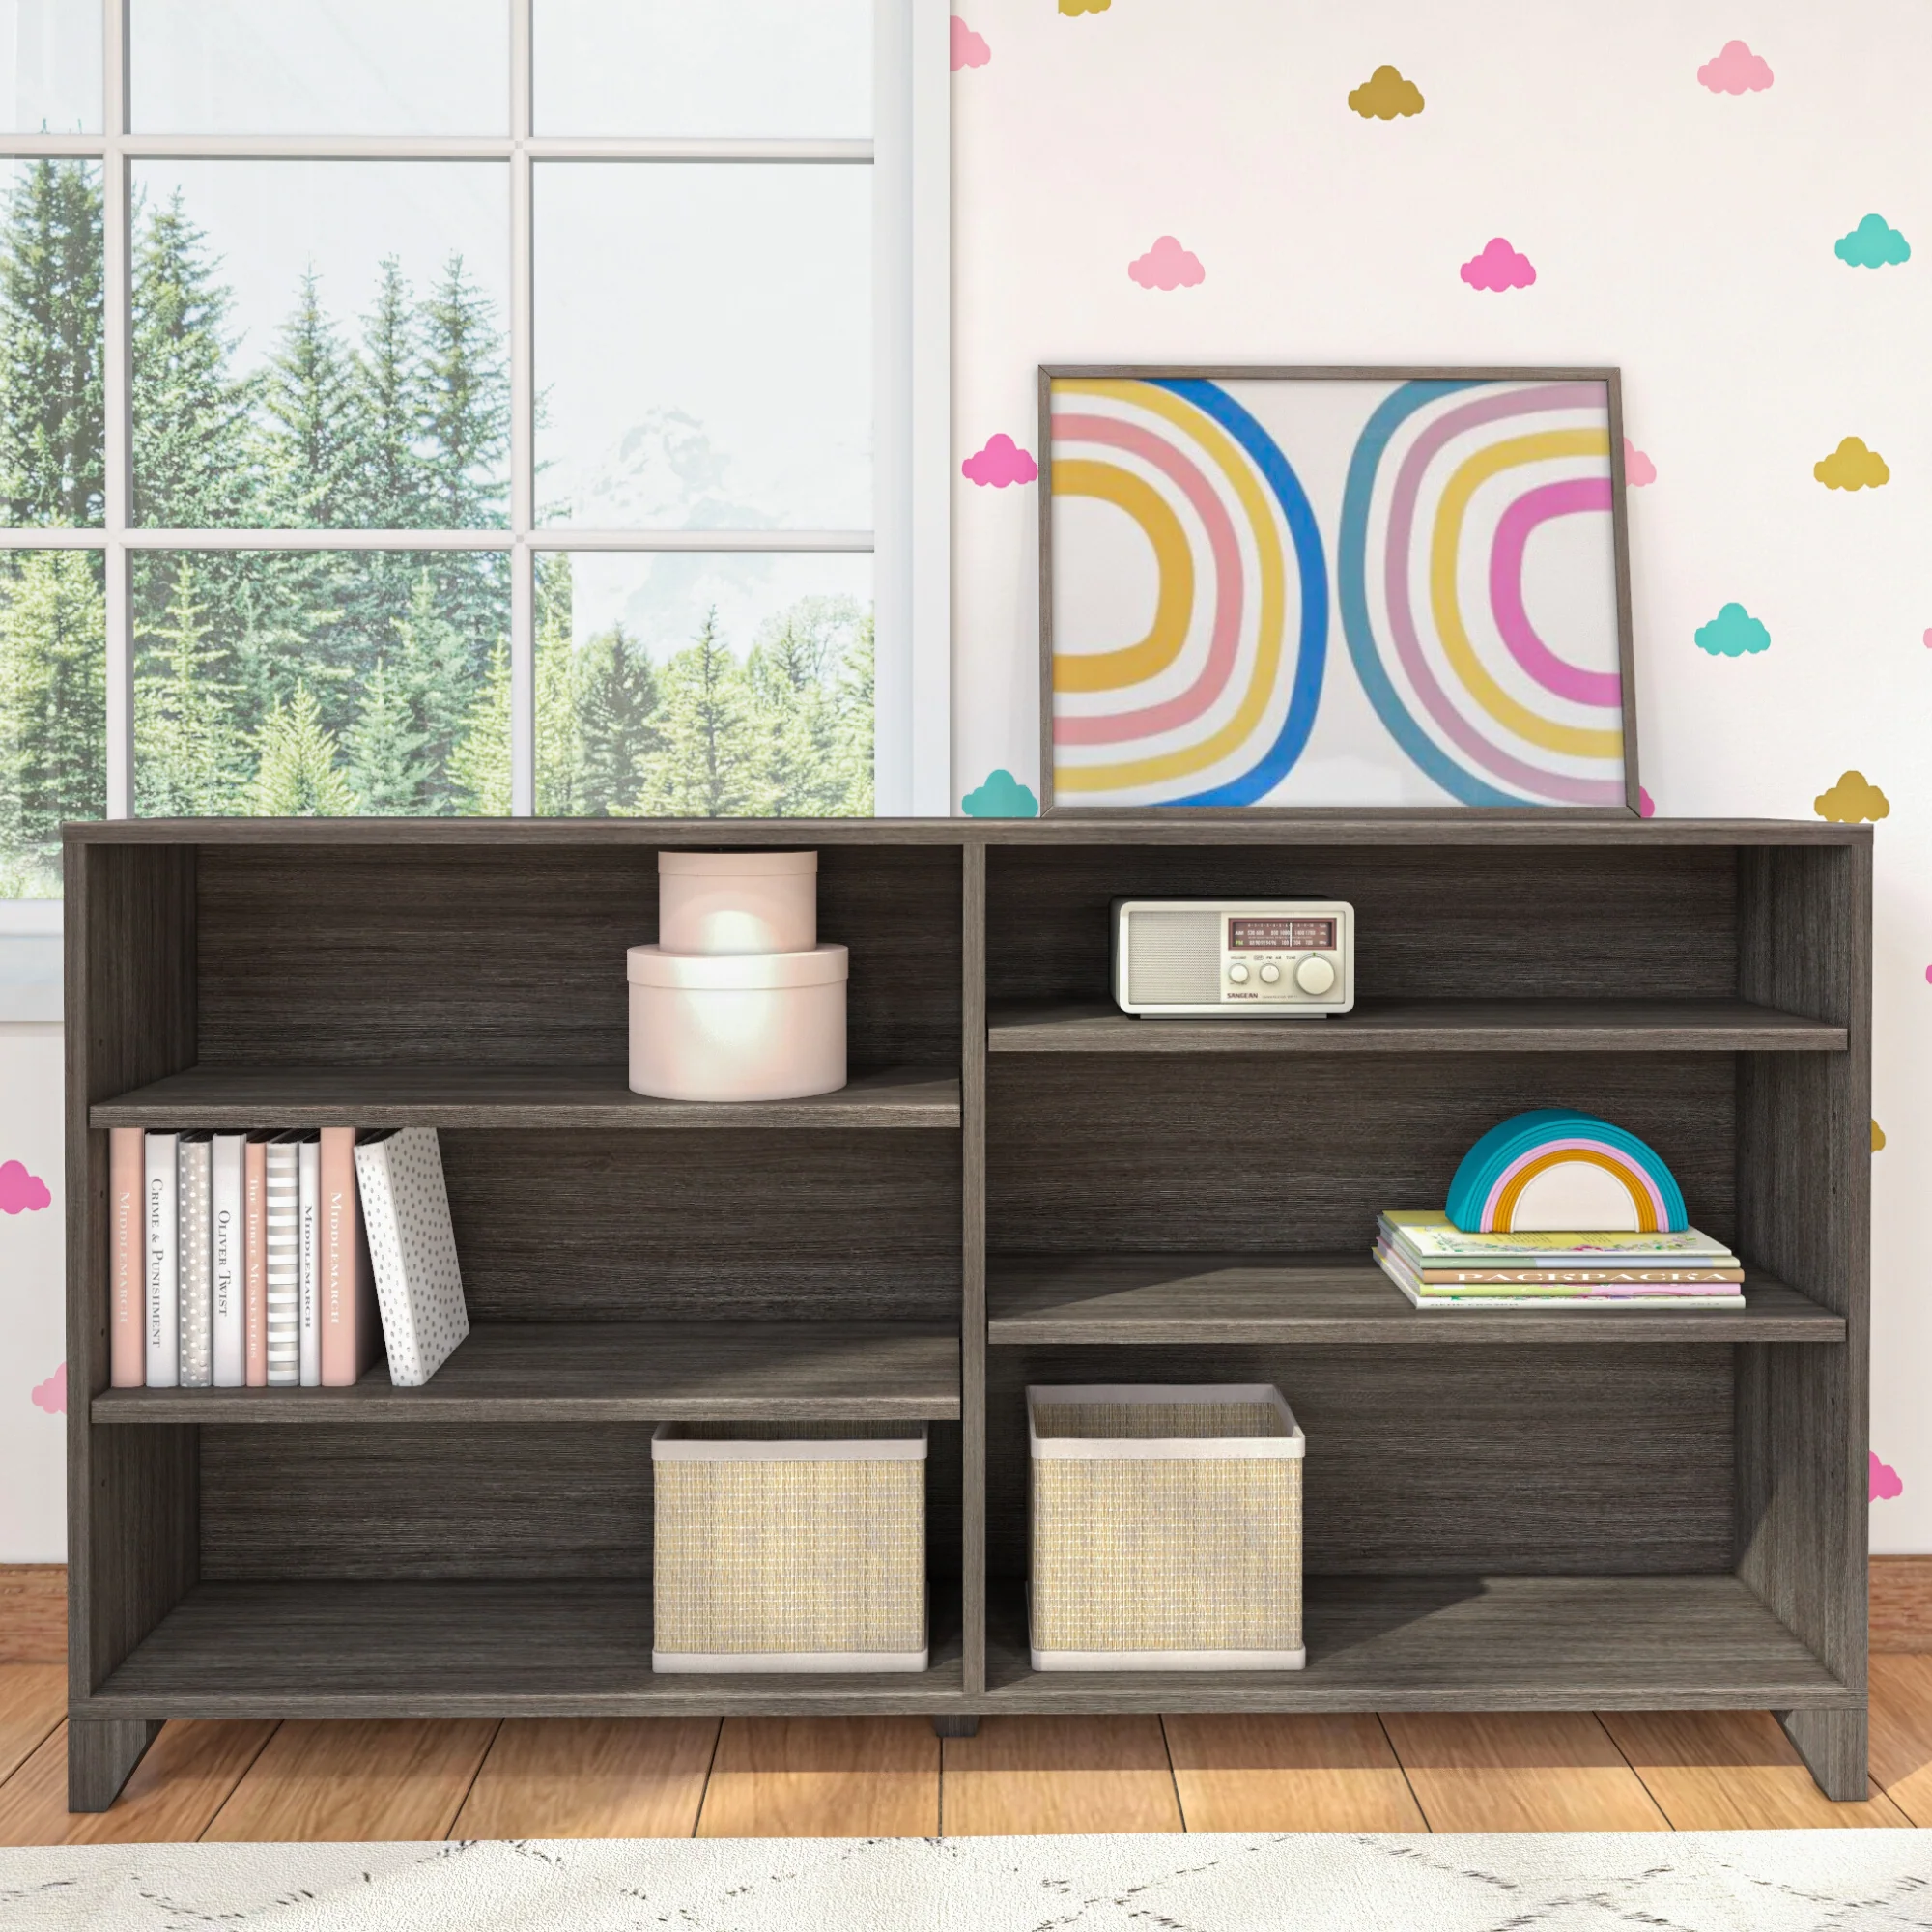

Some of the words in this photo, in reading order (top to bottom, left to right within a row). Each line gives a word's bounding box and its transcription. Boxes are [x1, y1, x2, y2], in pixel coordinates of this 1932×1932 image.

[151, 1179, 164, 1228] CRIME
[151, 1233, 161, 1243] &
[218, 1210, 231, 1266] OLIVER
[249, 1208, 260, 1257] THREE
[119, 1191, 131, 1323] MIDDLEMARCH
[218, 1270, 231, 1318] TWIST
[304, 1206, 314, 1329] MIDDLEMARCH
[330, 1192, 343, 1324] MIDDLEMARCH
[151, 1248, 164, 1349] PUNISHMENT
[249, 1264, 261, 1359] MUSKETEERS
